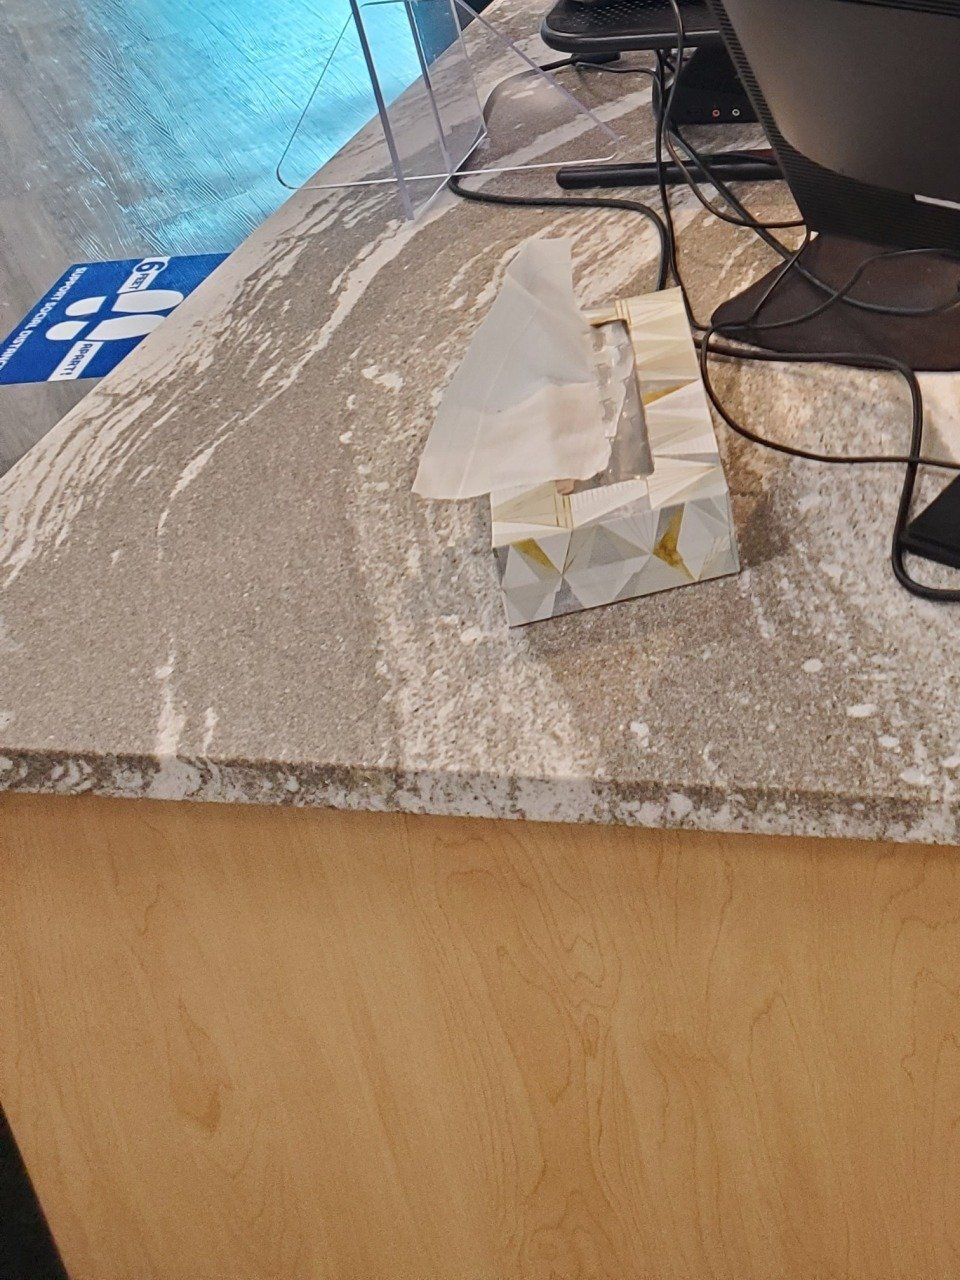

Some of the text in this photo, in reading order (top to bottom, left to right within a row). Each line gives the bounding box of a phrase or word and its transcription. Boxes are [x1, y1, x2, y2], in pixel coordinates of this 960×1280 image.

[51, 266, 88, 301] SUPPORT
[129, 261, 166, 289] 6 FEET
[24, 301, 59, 329] SOCIAL
[60, 343, 93, 376] APART!
